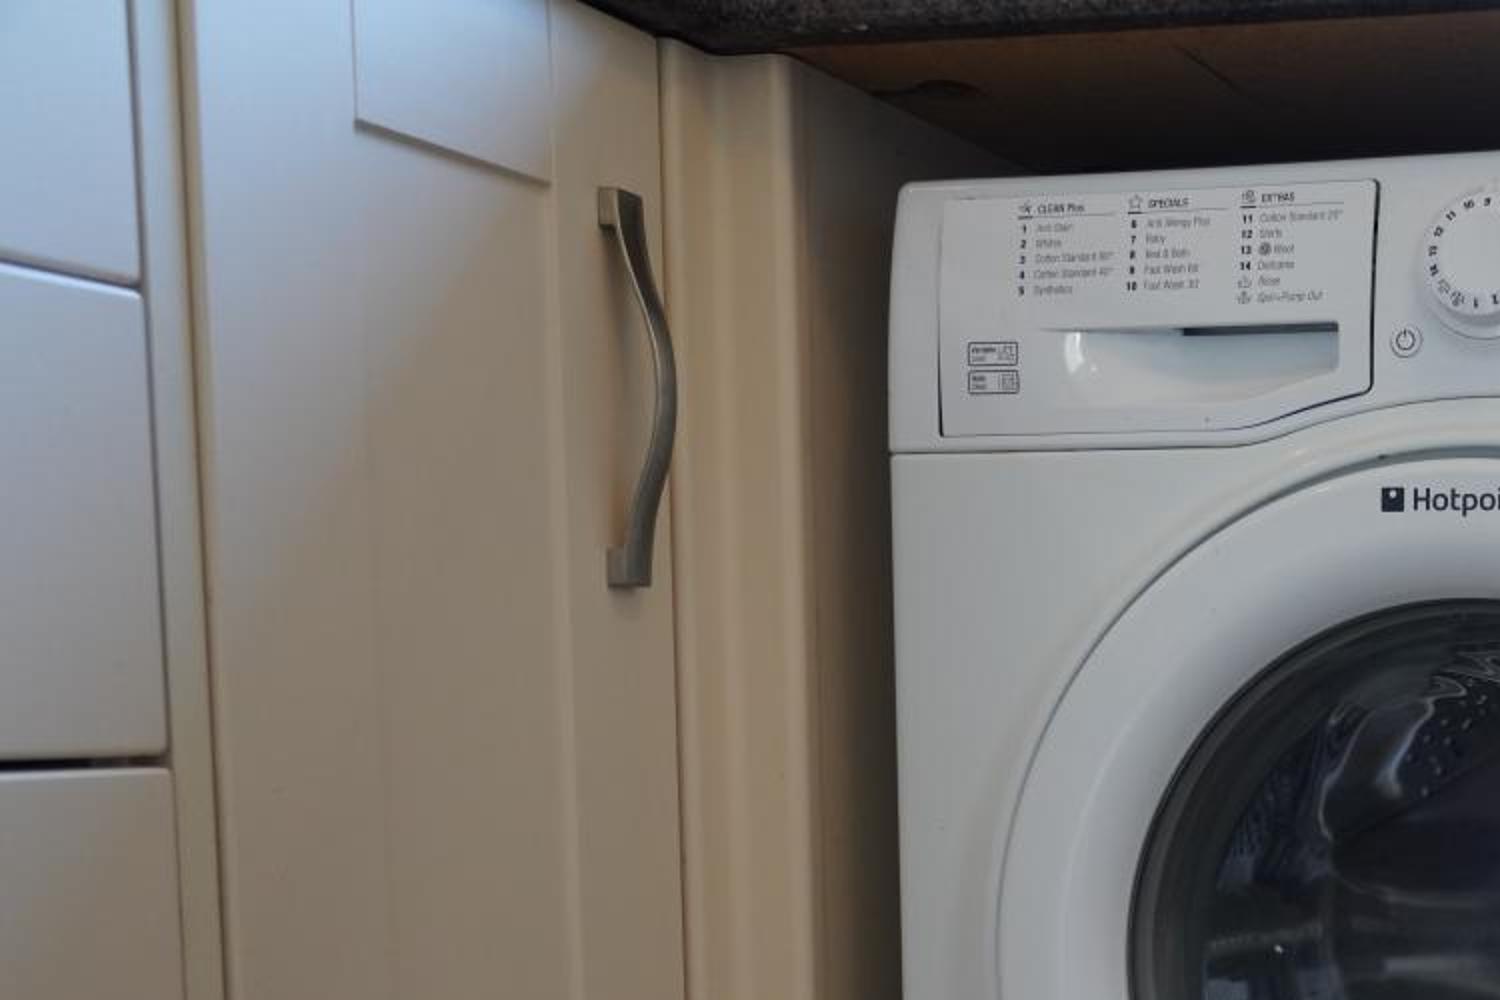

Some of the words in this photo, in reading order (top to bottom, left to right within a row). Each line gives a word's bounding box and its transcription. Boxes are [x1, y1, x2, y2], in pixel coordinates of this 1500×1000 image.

[1147, 197, 1190, 209] SPECIALS
[1243, 213, 1253, 224] 11
[1240, 261, 1251, 271] 14
